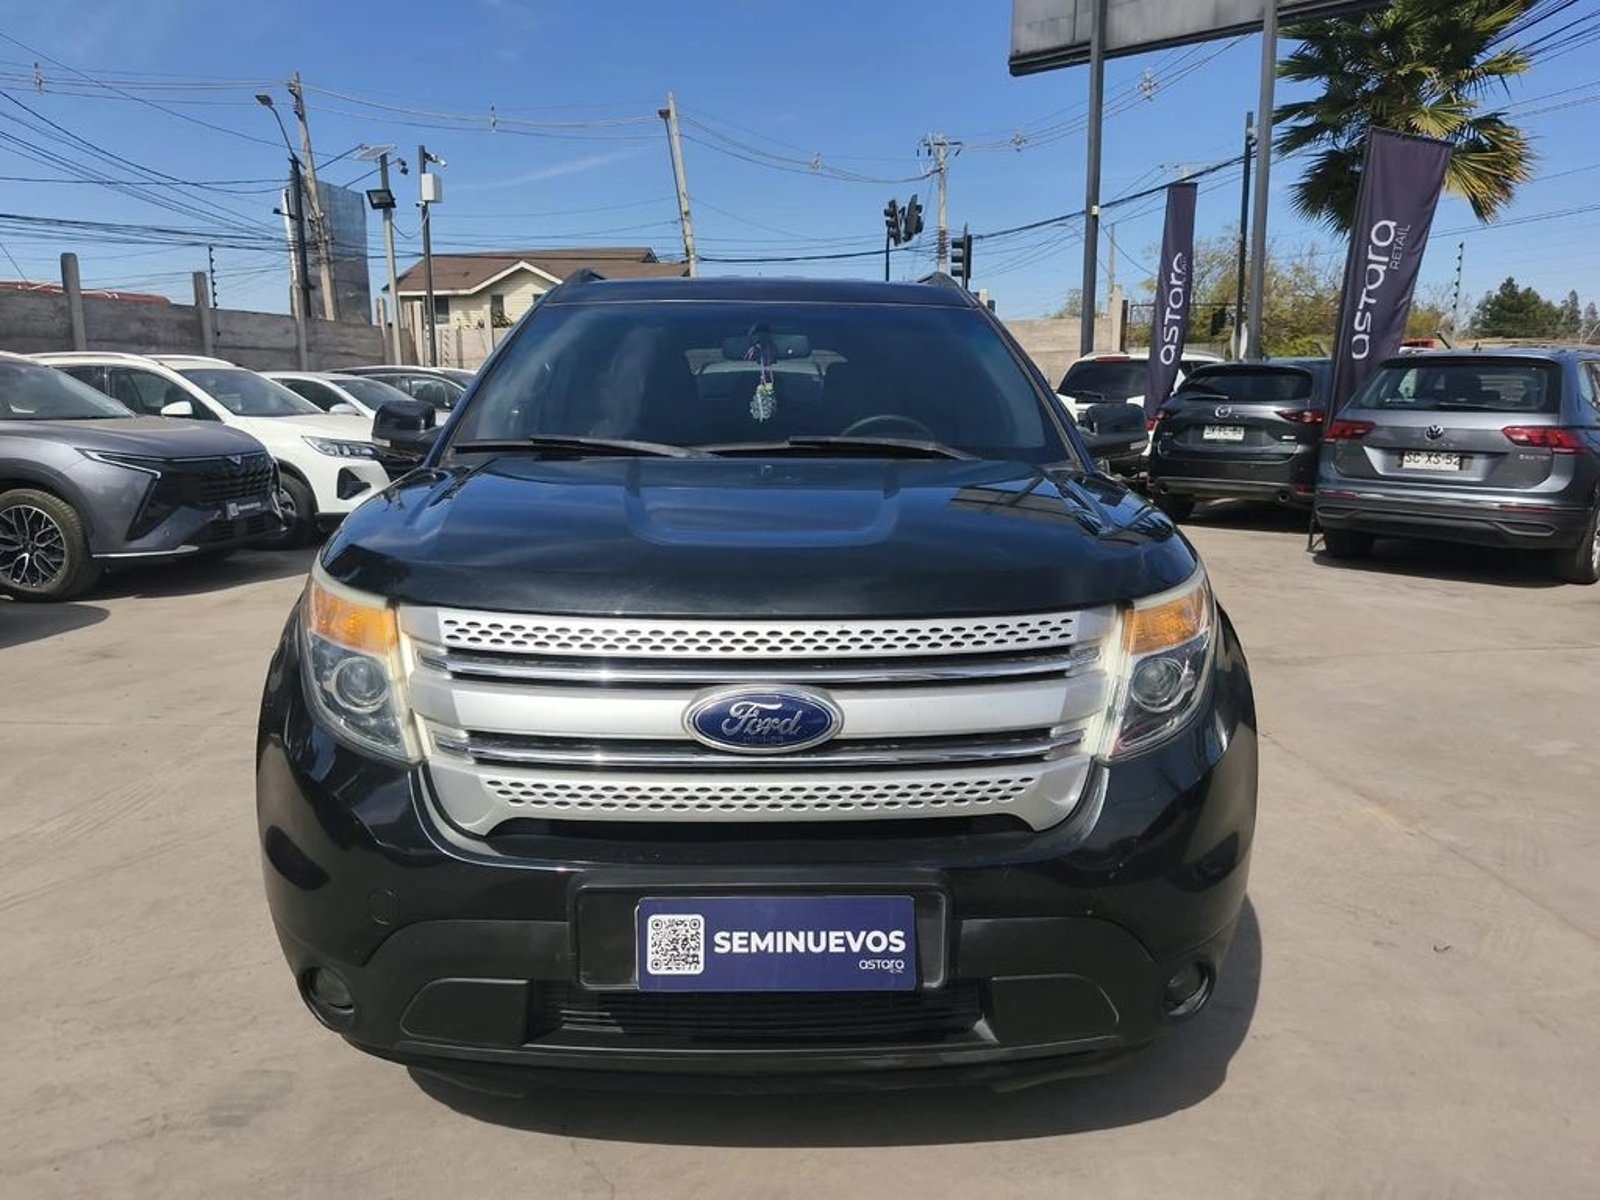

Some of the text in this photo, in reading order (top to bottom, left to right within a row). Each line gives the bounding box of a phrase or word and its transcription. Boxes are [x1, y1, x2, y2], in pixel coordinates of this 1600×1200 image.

[1390, 224, 1411, 270] RETAIL
[721, 701, 803, 736] Ford
[713, 930, 906, 953] SEMINUEVOS
[858, 959, 905, 970] astara
